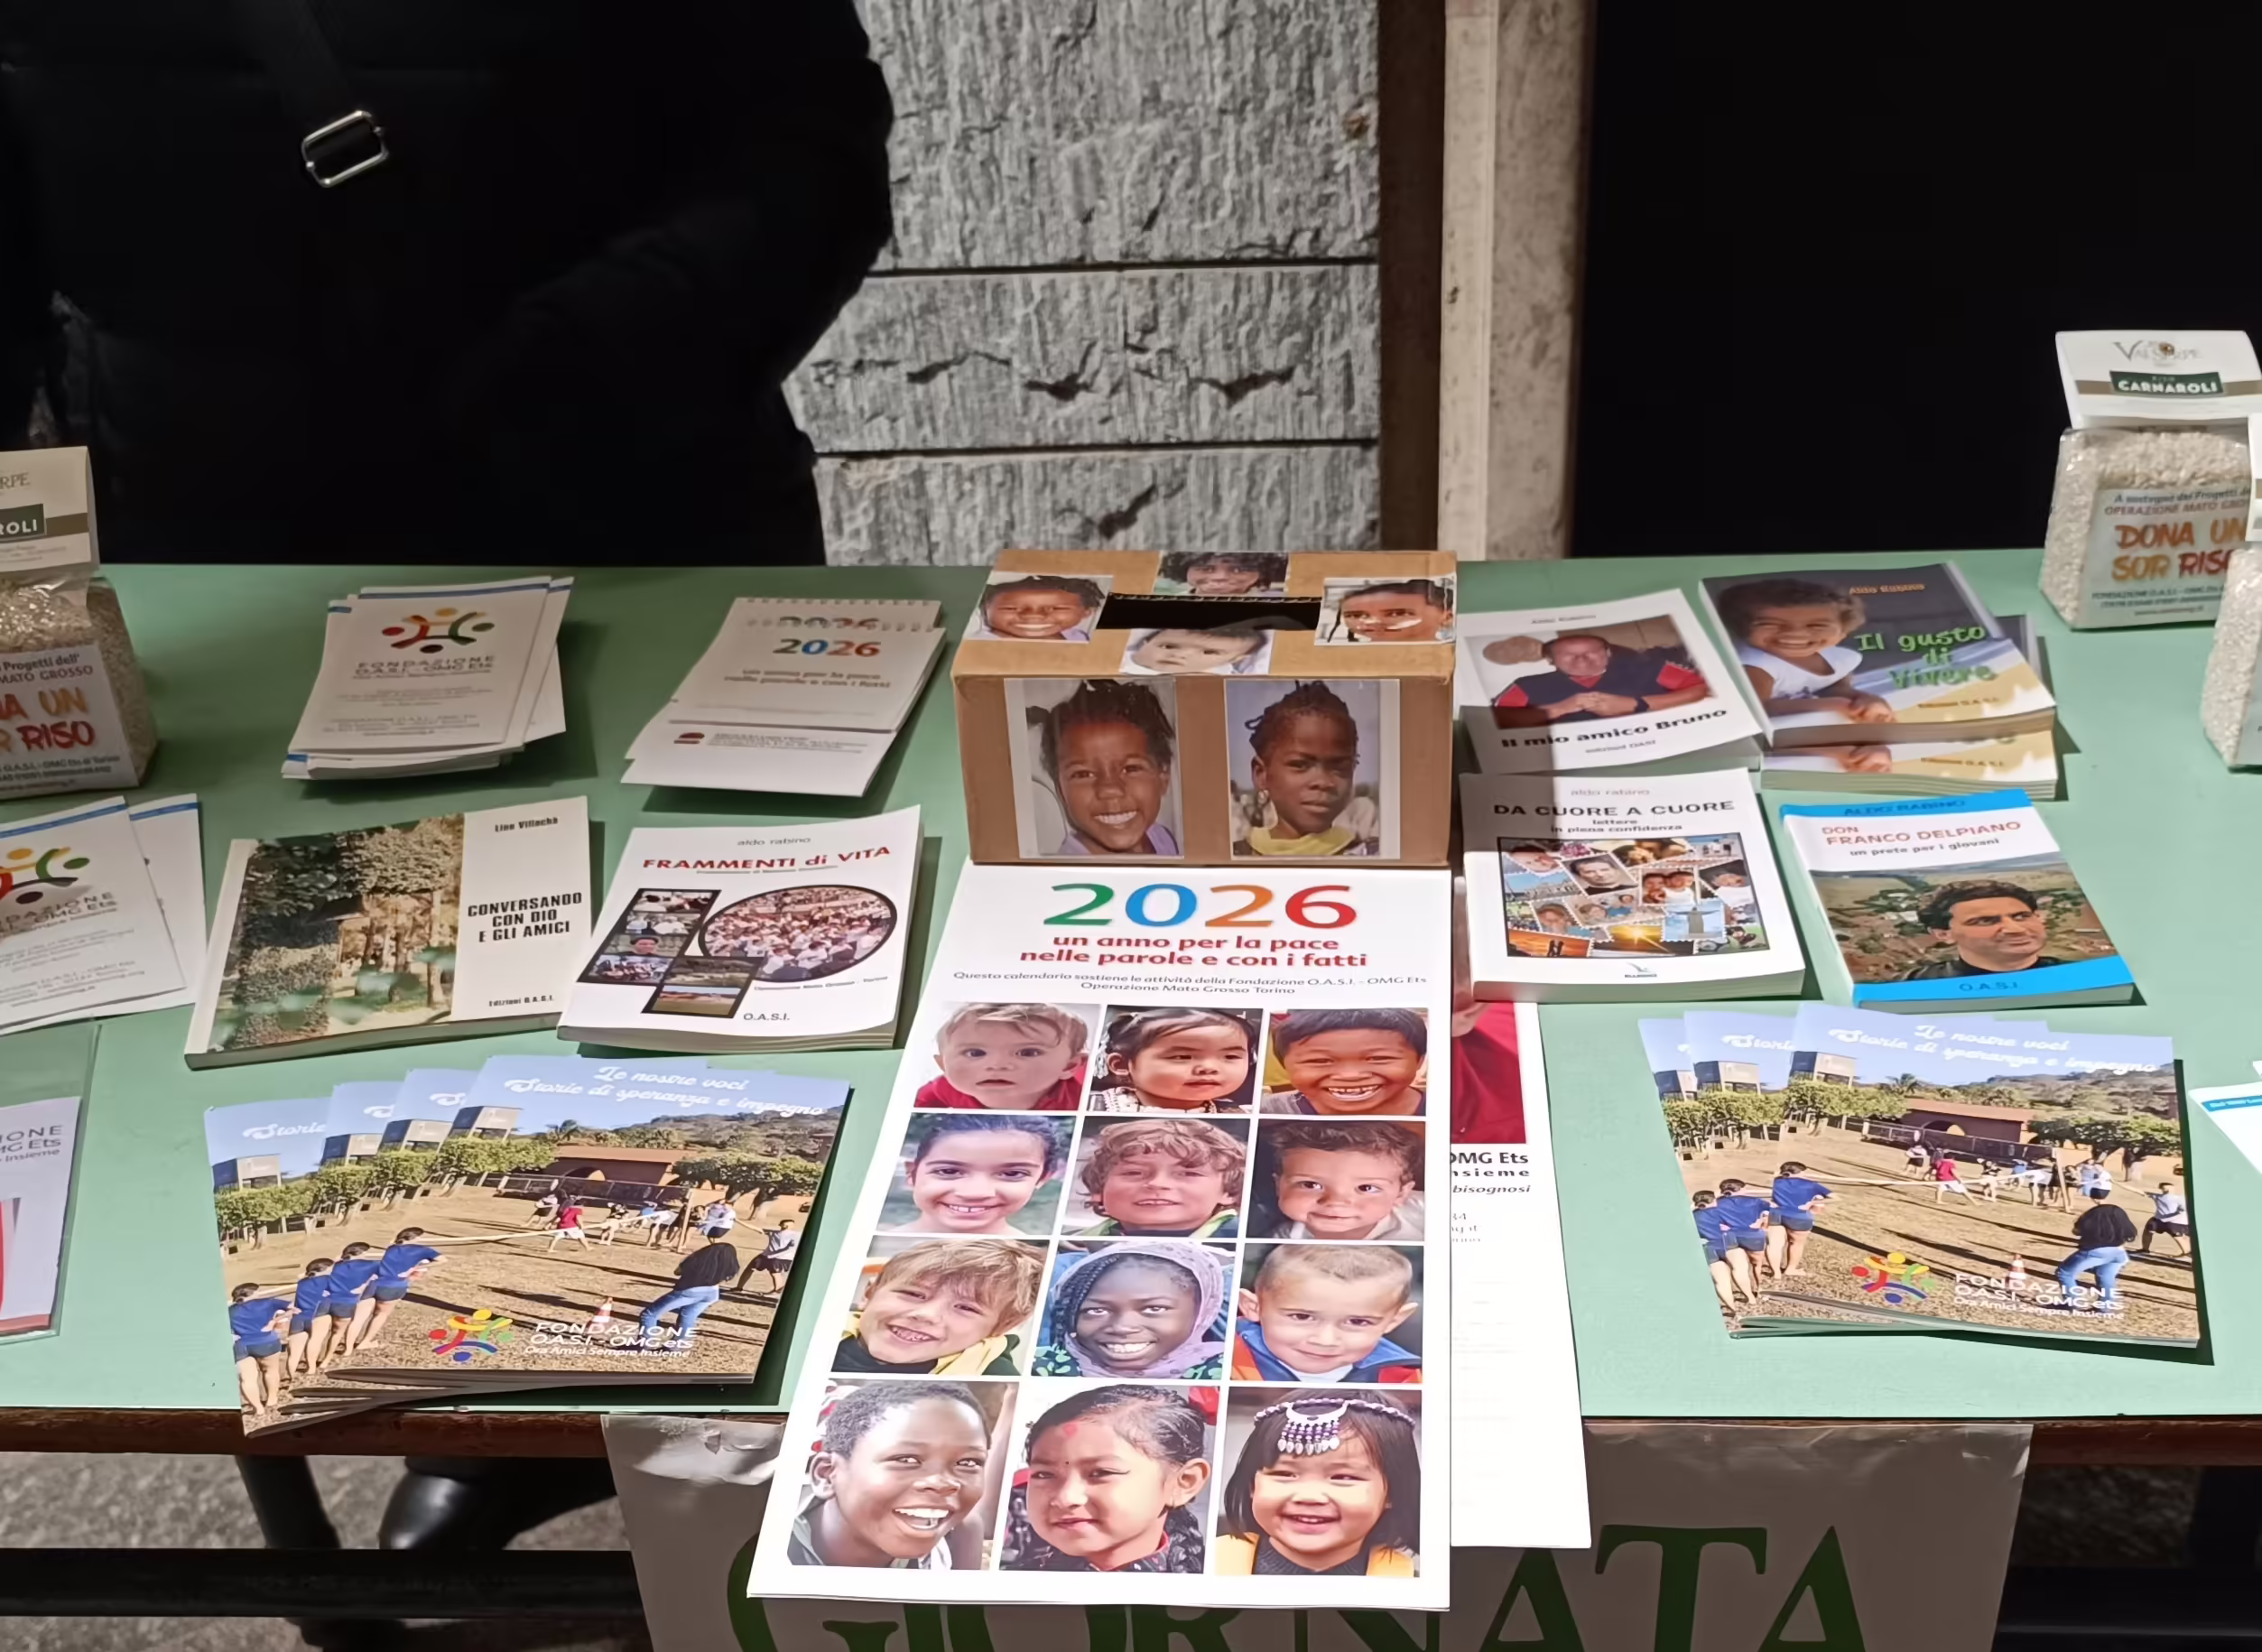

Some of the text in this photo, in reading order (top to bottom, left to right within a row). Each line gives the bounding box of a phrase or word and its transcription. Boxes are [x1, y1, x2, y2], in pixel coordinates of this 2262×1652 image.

[2118, 379, 2219, 394] CARNAROLI
[2114, 520, 2195, 550] DONA
[2111, 553, 2171, 583] SOR
[773, 638, 882, 657] 2026
[1853, 626, 1987, 653] Il gusto
[3, 656, 54, 673] Progetti
[1922, 646, 1952, 665] di
[40, 664, 95, 682] GROSSO
[38, 686, 88, 716] UN
[15, 720, 96, 752] RISO
[1501, 709, 1728, 748] Il mio amico Bruno
[1493, 800, 1736, 817] DA CUORE A CUORE
[495, 823, 515, 833] Lino
[1550, 825, 1563, 833] in
[1608, 823, 1683, 833] confidenza
[1822, 825, 1859, 835] DON
[1826, 821, 2022, 846] FRANCO DELPIANO
[770, 837, 811, 846] rabino
[1849, 849, 1868, 857] un
[1871, 846, 1908, 857] prete
[1912, 844, 1935, 855] per
[1948, 837, 2000, 852] giovani
[642, 846, 891, 869] FRAMMENTI di VITA
[468, 891, 583, 918] CONVERSANDO
[1043, 882, 1358, 930] 2026
[492, 908, 558, 928] CON DIO
[478, 920, 570, 942] E GLI AMICI
[1052, 934, 1340, 954] un anno per la pace
[1019, 949, 1369, 968] nelle parole e con i fatti
[953, 970, 1002, 980] Questo
[1004, 971, 1072, 980] calendario
[1074, 973, 1128, 982] sostiene
[1130, 974, 1142, 983] le
[1194, 976, 1227, 985] della
[1228, 977, 1305, 986] Fondazione
[1367, 976, 1404, 985] OMG
[1080, 981, 1296, 995] Operazione Mato Grosso Torino
[743, 1012, 792, 1022] O.A.S.I.
[2023, 1040, 2071, 1052] voci
[2064, 1056, 2159, 1074] impegno
[630, 1072, 698, 1086] nostre
[701, 1079, 751, 1091] voci
[503, 1078, 828, 1118] Storie di speranza e impegno
[1498, 1152, 1529, 1164] Ets
[1452, 1167, 1530, 1177] nsieme
[1452, 1184, 1532, 1195] bisognosi
[1953, 1272, 2126, 1299] FONDAZIONE
[1953, 1296, 2126, 1321] Ora Amici Sempre Insieme
[2035, 1294, 2089, 1308] OMG
[2096, 1300, 2125, 1311] ets
[534, 1321, 699, 1338] FONDAZIONE
[524, 1344, 549, 1354] Ora
[549, 1344, 588, 1355] Amici
[589, 1346, 639, 1357] Sempre
[609, 1336, 661, 1348] OMG
[662, 1338, 695, 1350] ets
